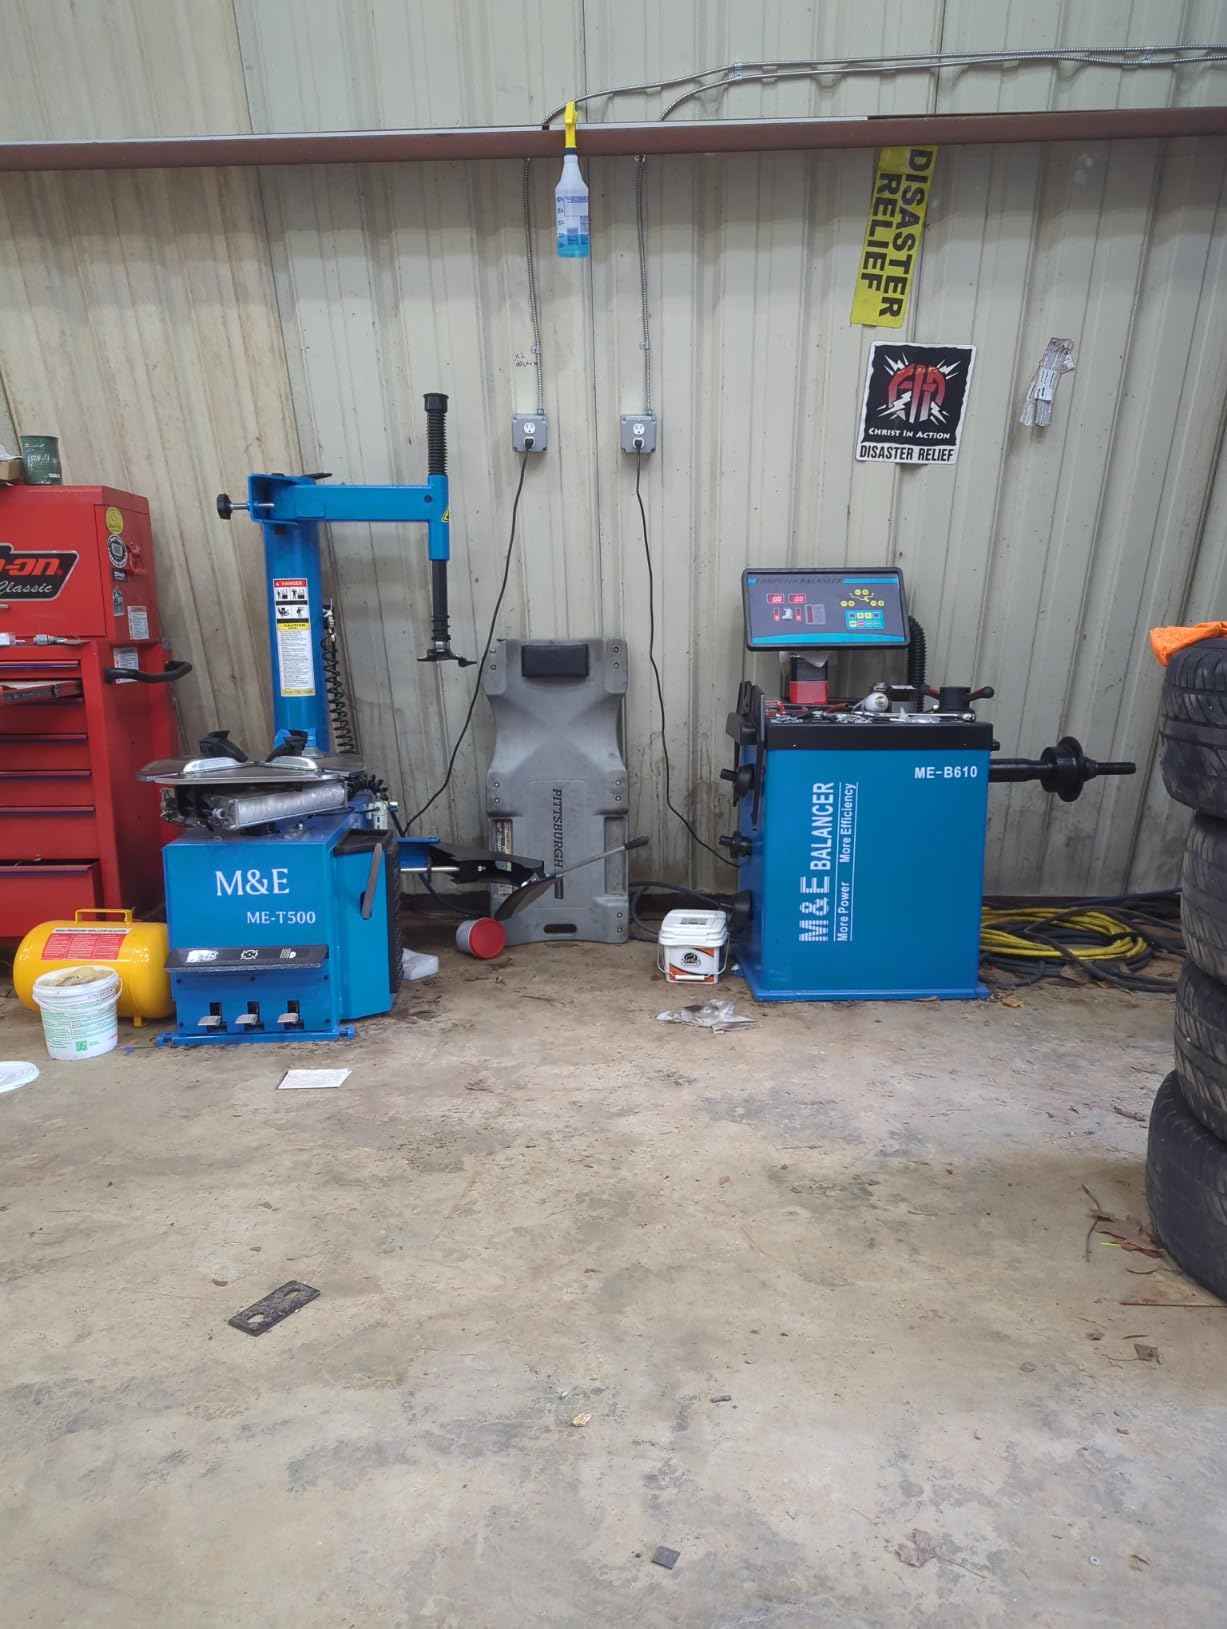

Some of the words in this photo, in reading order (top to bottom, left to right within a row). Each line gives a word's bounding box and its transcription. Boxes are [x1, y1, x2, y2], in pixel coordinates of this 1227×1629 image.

[861, 173, 903, 292] RELIEF
[879, 149, 933, 318] DISASTER
[868, 427, 901, 437] CHRIST
[903, 429, 914, 437] IN
[916, 431, 951, 440] ACTION
[859, 445, 914, 460] DISASTER
[918, 447, 954, 462] RELIEF
[0, 580, 53, 595] Classic
[914, 766, 978, 779] ME-B610
[840, 783, 857, 835] Efficiency
[552, 787, 565, 869] PITTSBURGH
[809, 782, 835, 871] BALANCER
[839, 837, 851, 863] More
[215, 868, 290, 896] M&E
[838, 882, 850, 914] Power
[247, 911, 316, 924] ME-T500
[837, 917, 849, 942] More
